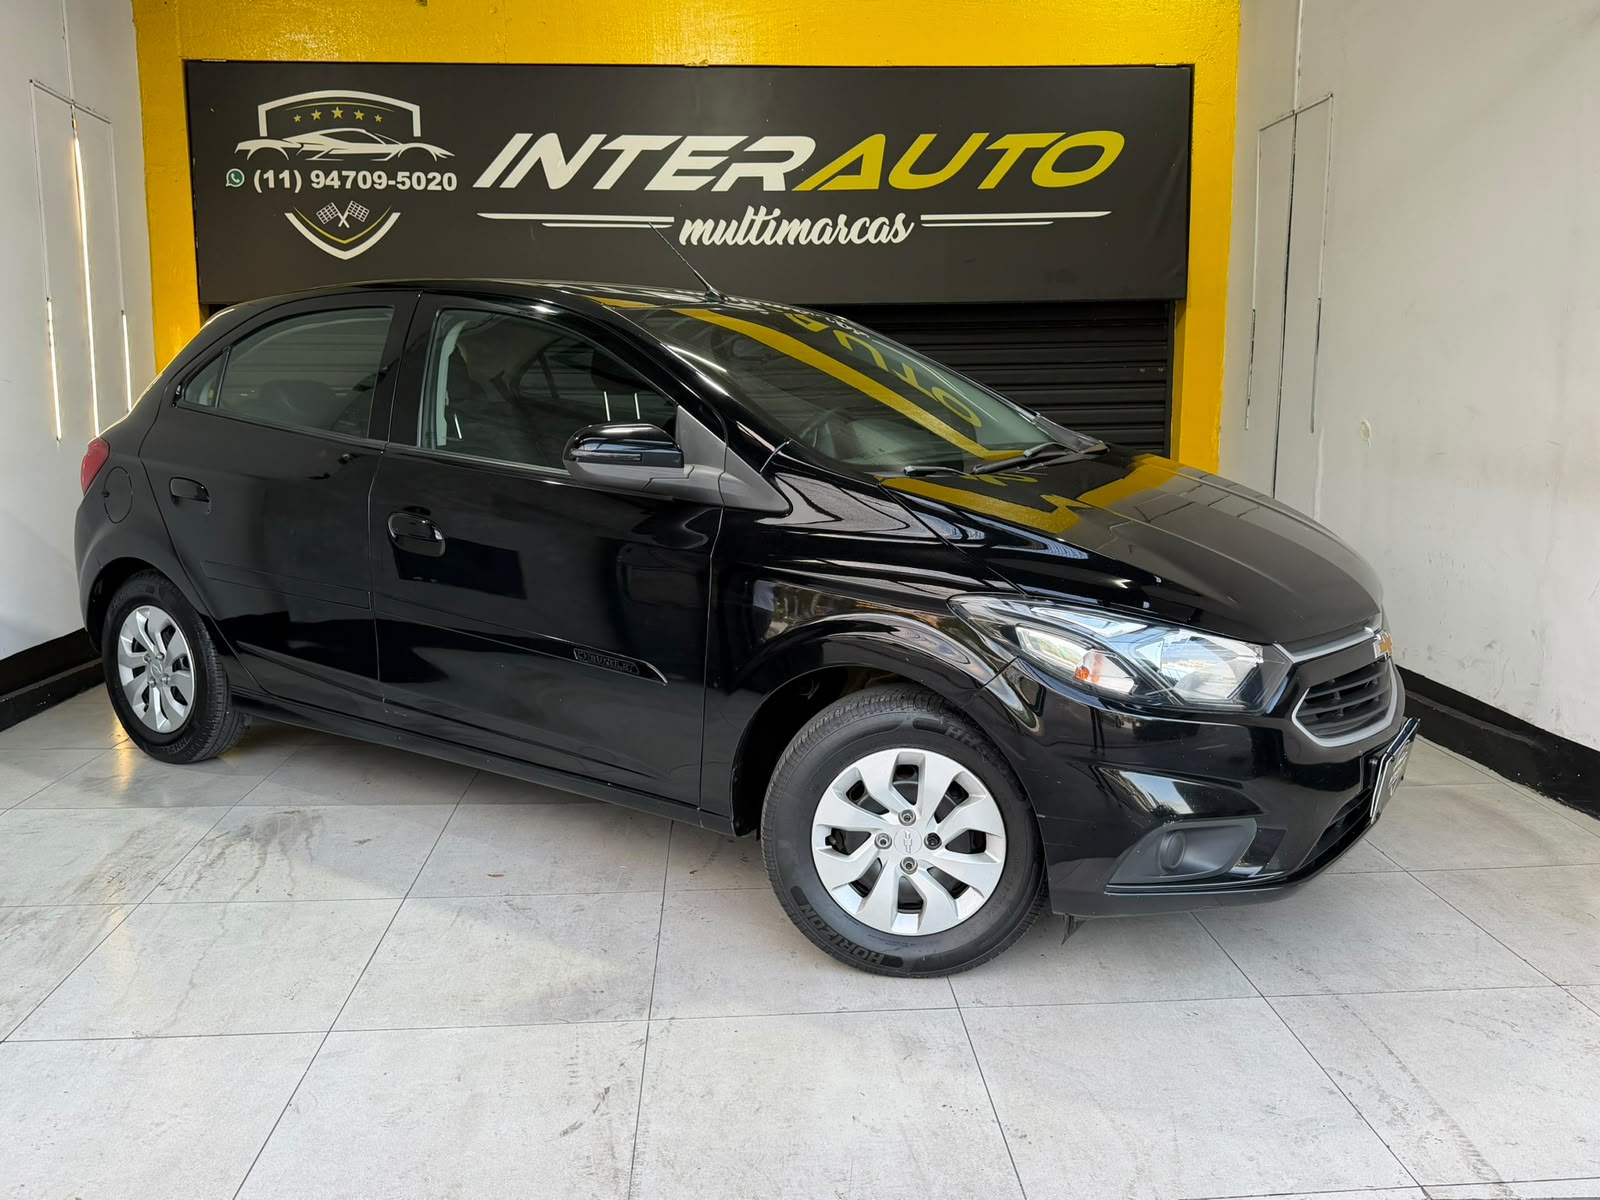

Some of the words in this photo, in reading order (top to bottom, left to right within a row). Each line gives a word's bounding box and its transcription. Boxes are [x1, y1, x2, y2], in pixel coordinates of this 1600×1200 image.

[253, 170, 302, 193] (11)
[311, 170, 458, 191] 94709-5020
[473, 131, 1124, 192] INTERAUTO
[679, 206, 914, 246] multimarcas
[799, 903, 884, 963] HORIZON
